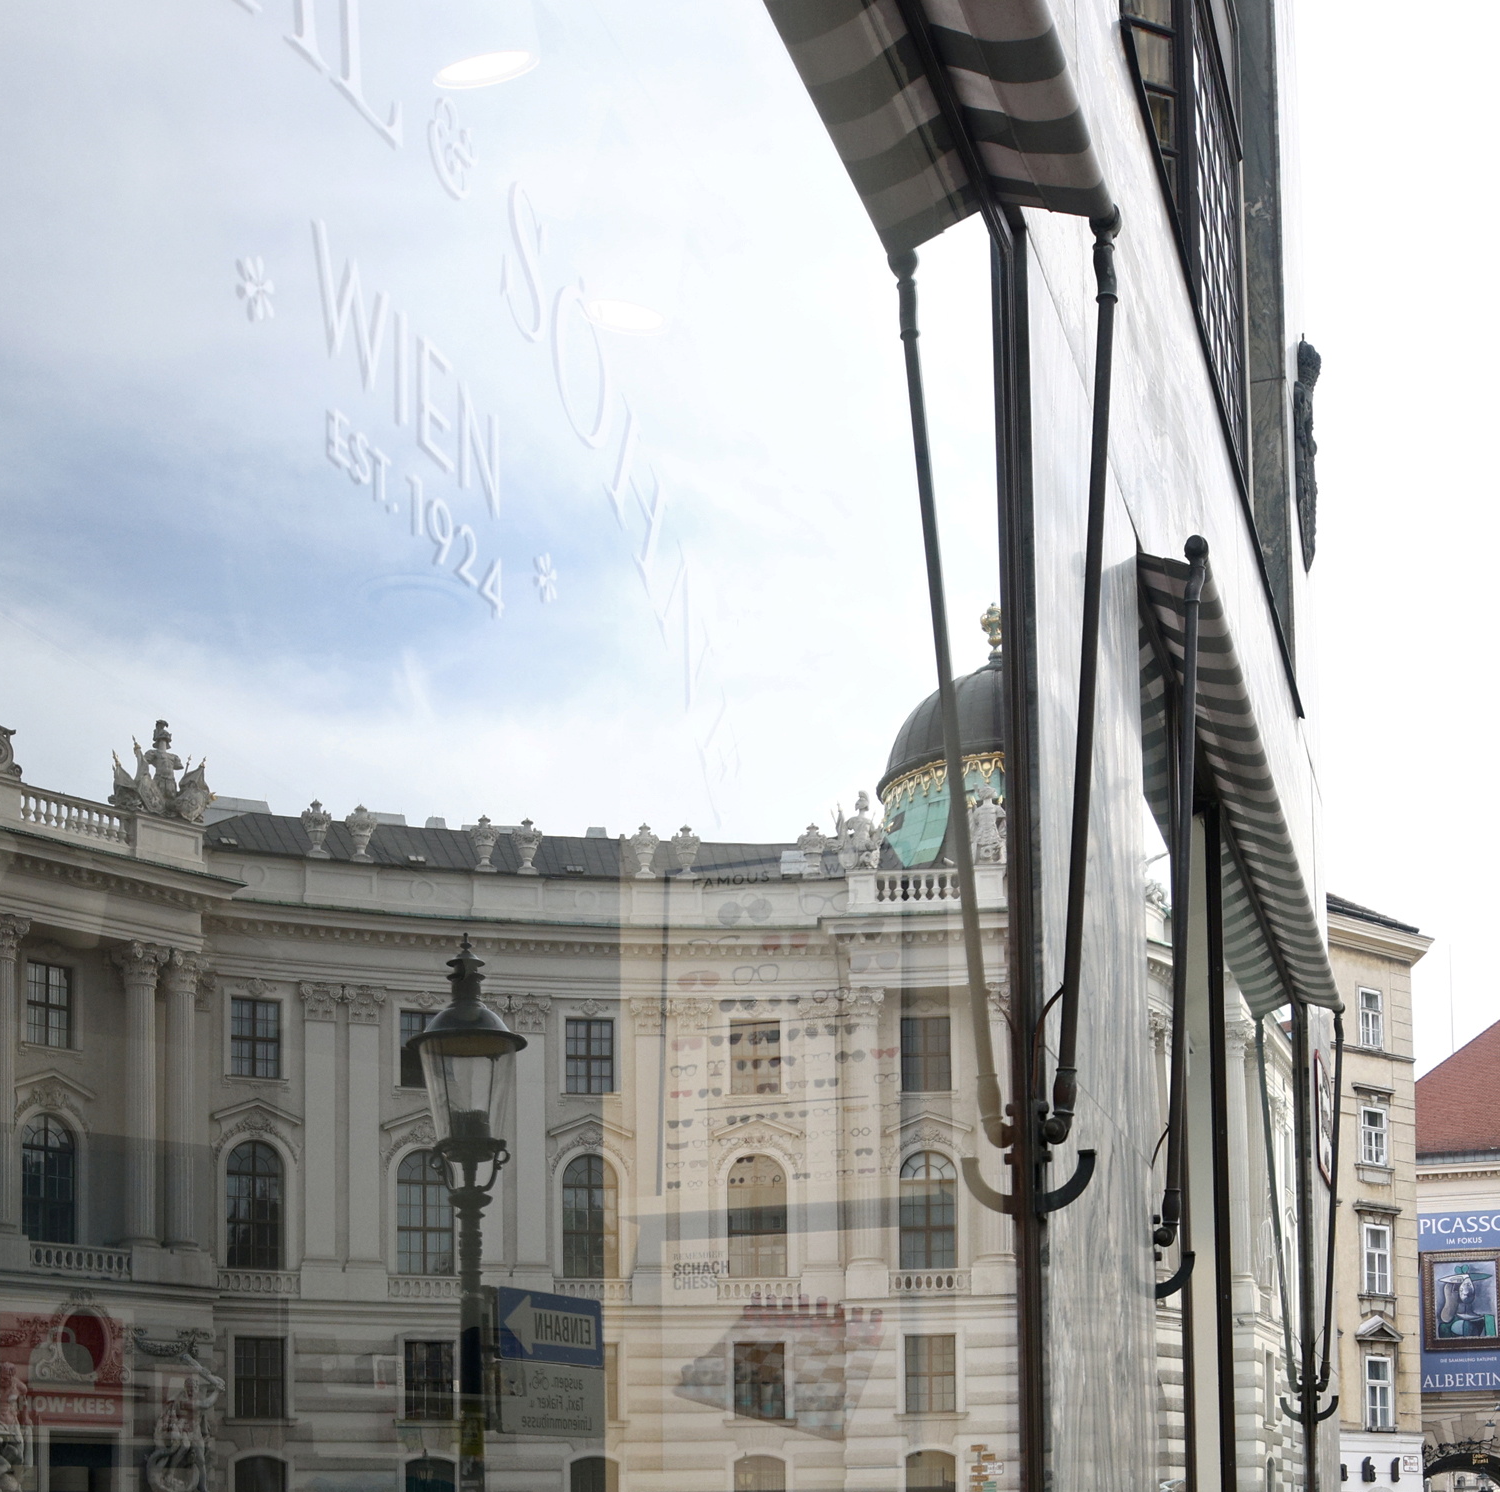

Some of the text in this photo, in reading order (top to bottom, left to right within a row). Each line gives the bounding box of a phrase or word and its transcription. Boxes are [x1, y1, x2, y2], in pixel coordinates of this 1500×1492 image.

[310, 218, 502, 522] WIEN
[325, 407, 506, 619] EST. 1924
[692, 871, 770, 890] FAMOUS
[1457, 1236, 1483, 1244] FOKUS
[673, 1259, 729, 1279] SCHACH
[673, 1275, 718, 1291] CHESS
[18, 1395, 116, 1415] HOW-KEES
